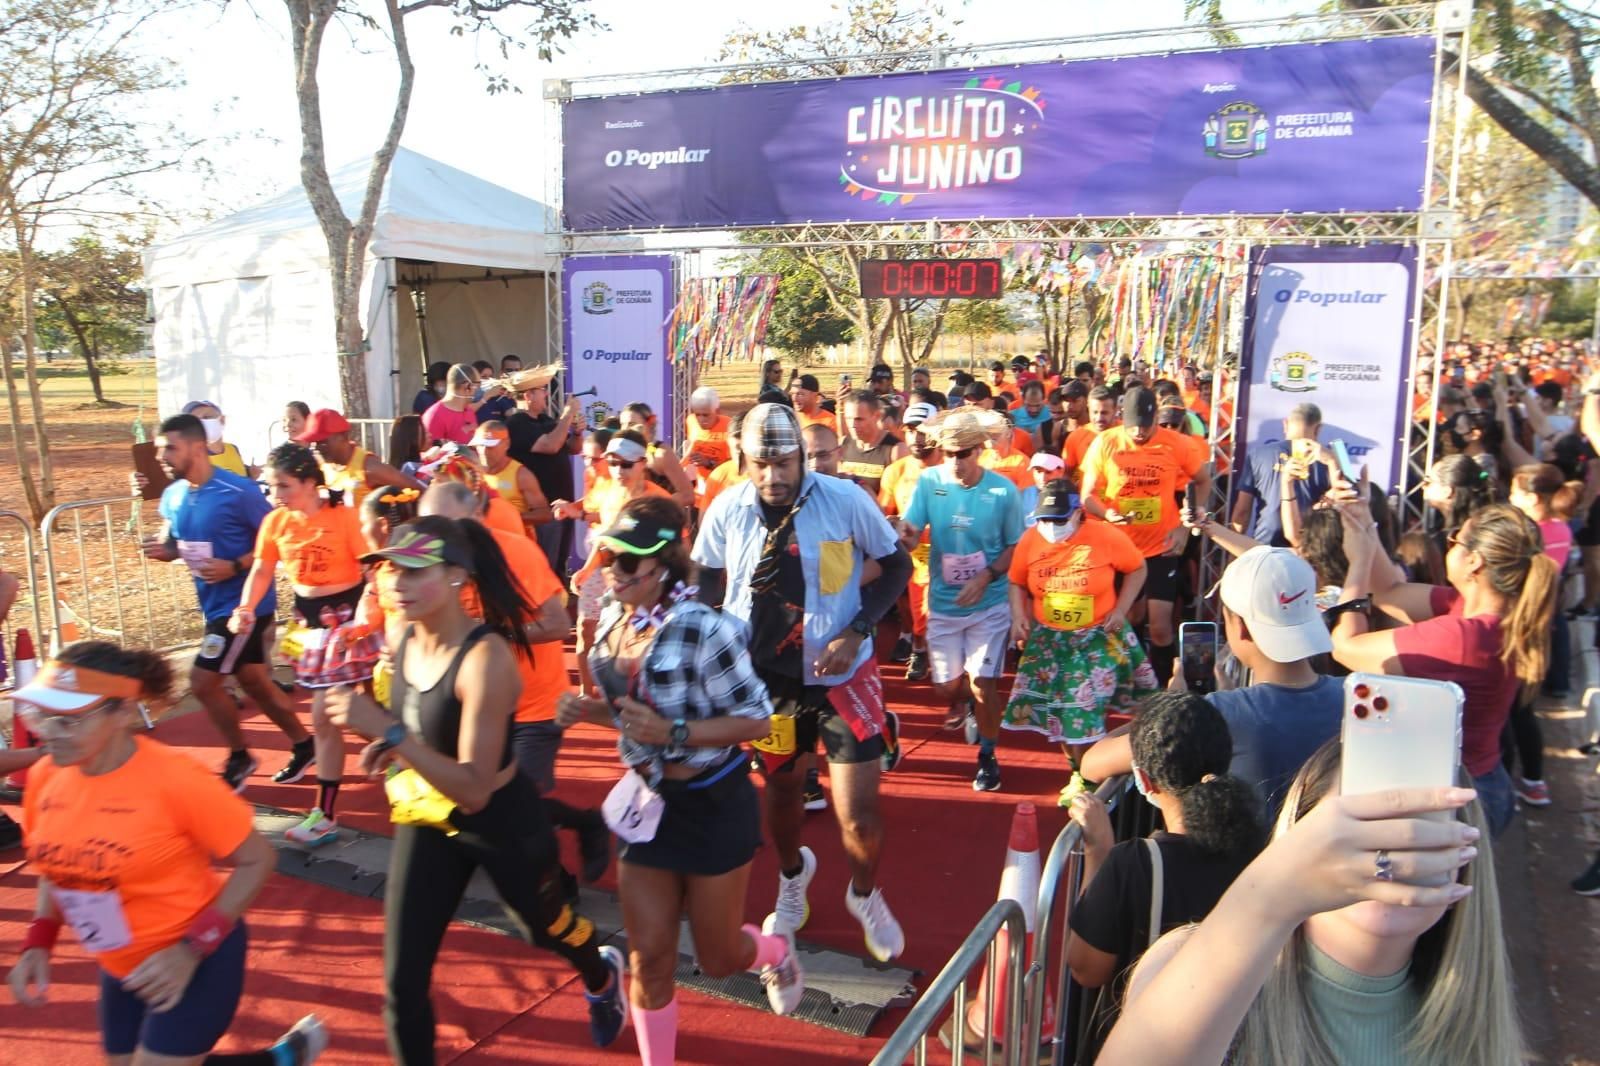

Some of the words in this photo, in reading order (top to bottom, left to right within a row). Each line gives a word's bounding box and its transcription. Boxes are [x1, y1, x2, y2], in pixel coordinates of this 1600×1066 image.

[1203, 82, 1236, 93] Apoio:
[1275, 112, 1354, 126] PREFEITURA
[1275, 127, 1292, 139] DE
[1295, 124, 1353, 138] GOIÂNIA
[605, 150, 623, 167] O
[624, 146, 711, 170] Popular
[882, 262, 999, 295] 0:00:07
[1275, 289, 1292, 303] O
[1295, 290, 1387, 307] Popular
[583, 349, 593, 361] O
[595, 349, 653, 363] Popular
[1324, 364, 1381, 372] PREFEITURA
[1324, 373, 1336, 381] DE
[1053, 609, 1082, 622] 567
